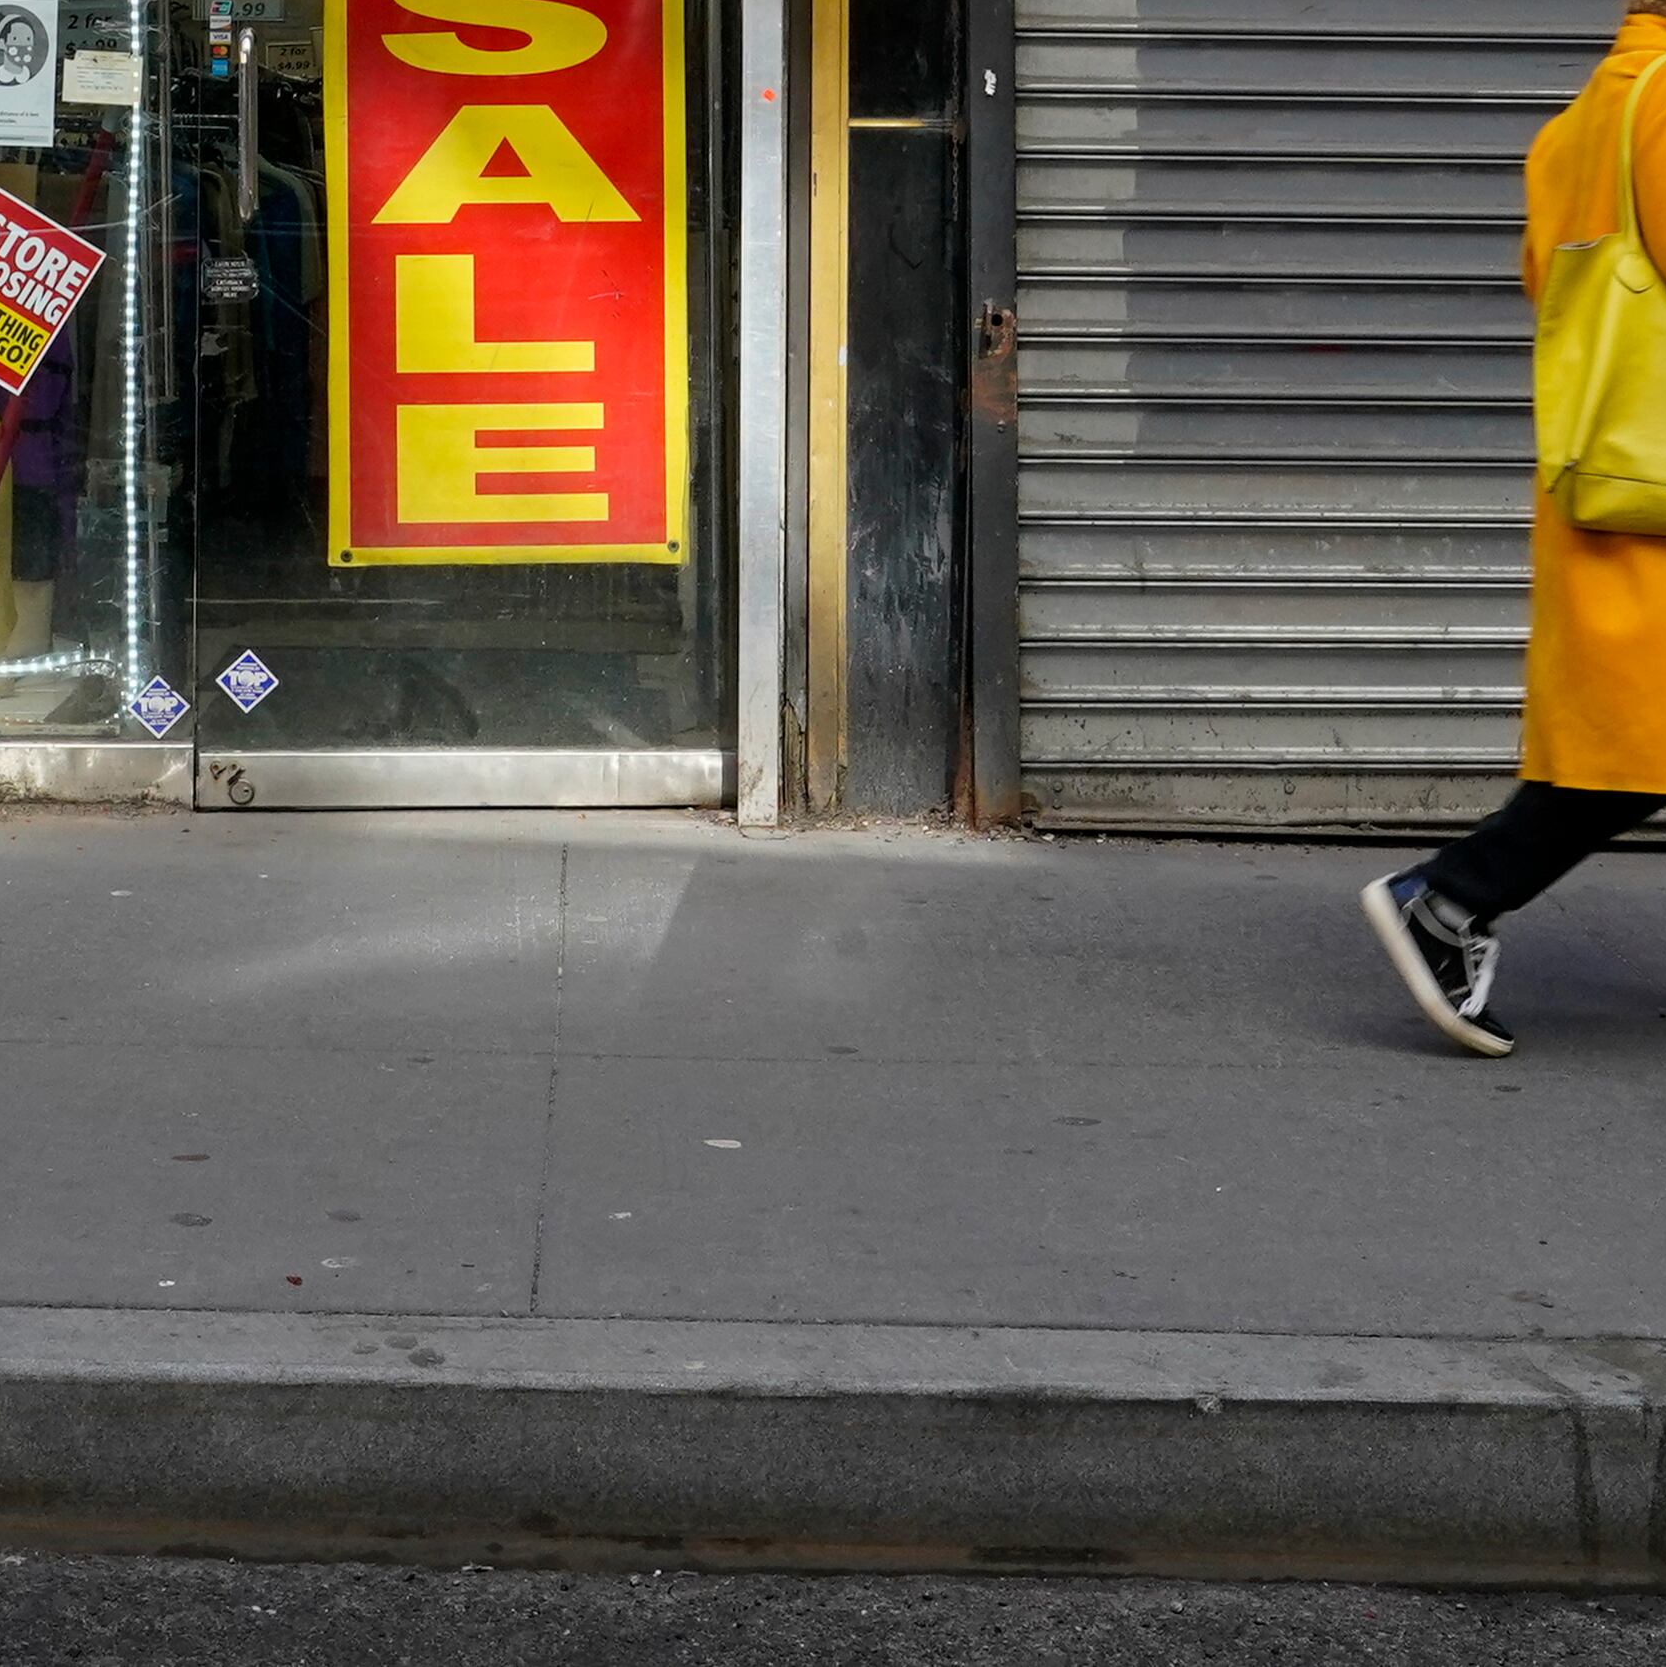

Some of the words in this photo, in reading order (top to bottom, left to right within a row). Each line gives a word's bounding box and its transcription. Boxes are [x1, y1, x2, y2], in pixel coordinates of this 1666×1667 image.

[67, 15, 79, 30] 2
[228, 670, 269, 686] TOP
[137, 696, 179, 713] TOP
